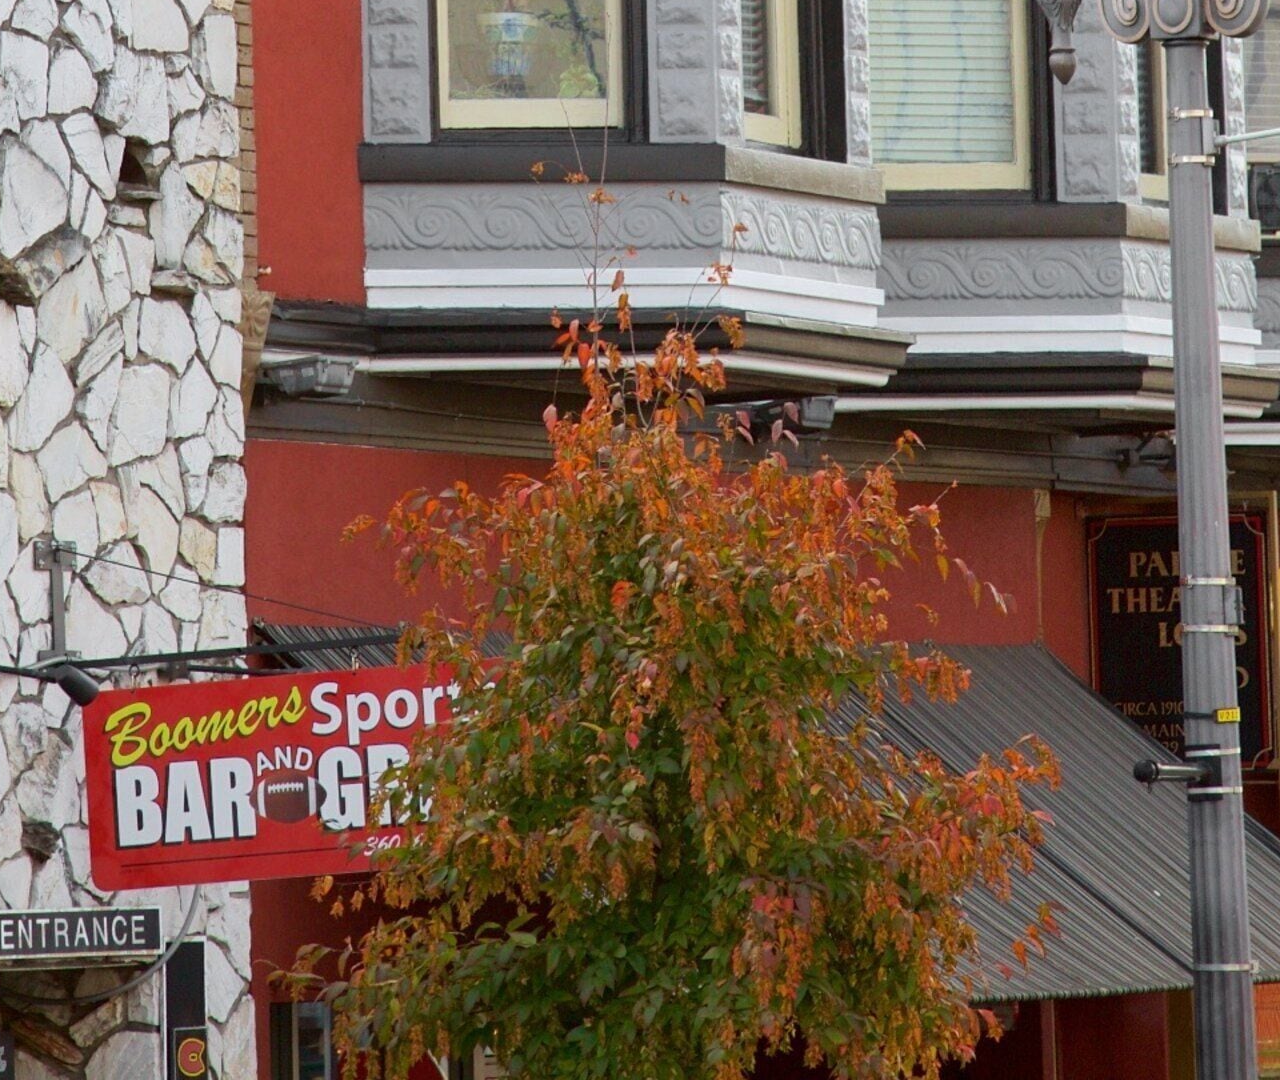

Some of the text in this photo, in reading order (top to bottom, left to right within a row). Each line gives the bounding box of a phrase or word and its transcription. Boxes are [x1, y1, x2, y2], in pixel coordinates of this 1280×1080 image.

[105, 686, 307, 767] Boomers
[115, 756, 257, 848] BAR
[256, 746, 313, 777] AND
[0, 915, 146, 950] ENTRANCE
